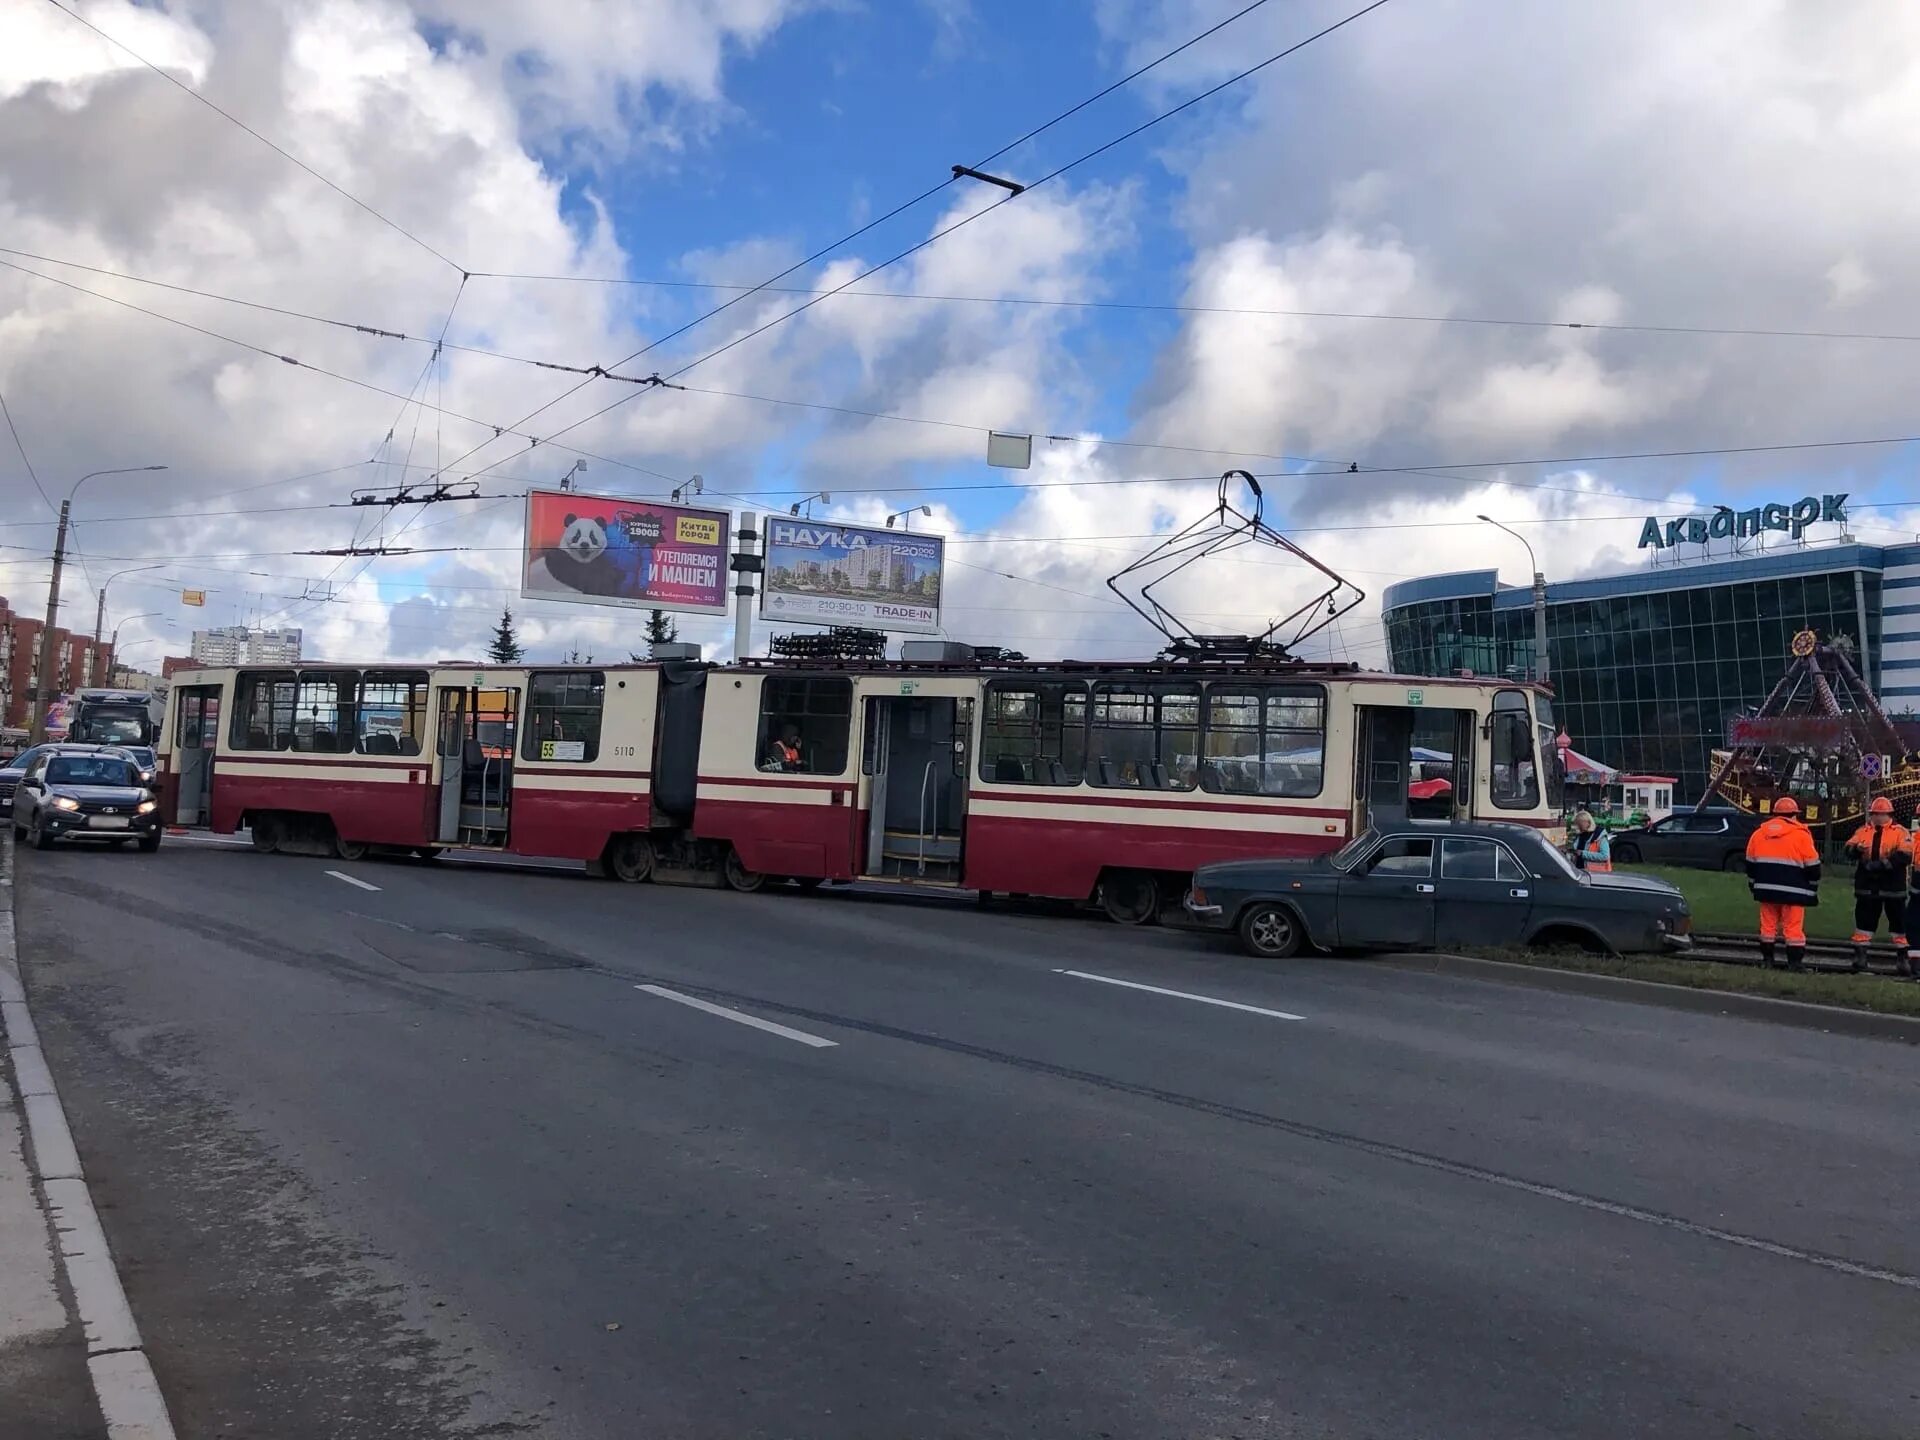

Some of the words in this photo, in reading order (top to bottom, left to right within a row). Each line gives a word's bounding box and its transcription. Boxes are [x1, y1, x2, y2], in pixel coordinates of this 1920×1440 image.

[774, 525, 868, 550] НАУКА
[656, 550, 717, 567] УТЕПЛЯЕМСЯ
[648, 563, 659, 582] И
[662, 565, 716, 587] МАШЕМ
[818, 600, 866, 612] 210-90-10
[874, 606, 932, 619] TRADE-IN
[543, 743, 554, 757] 55
[614, 746, 635, 757] 5110
